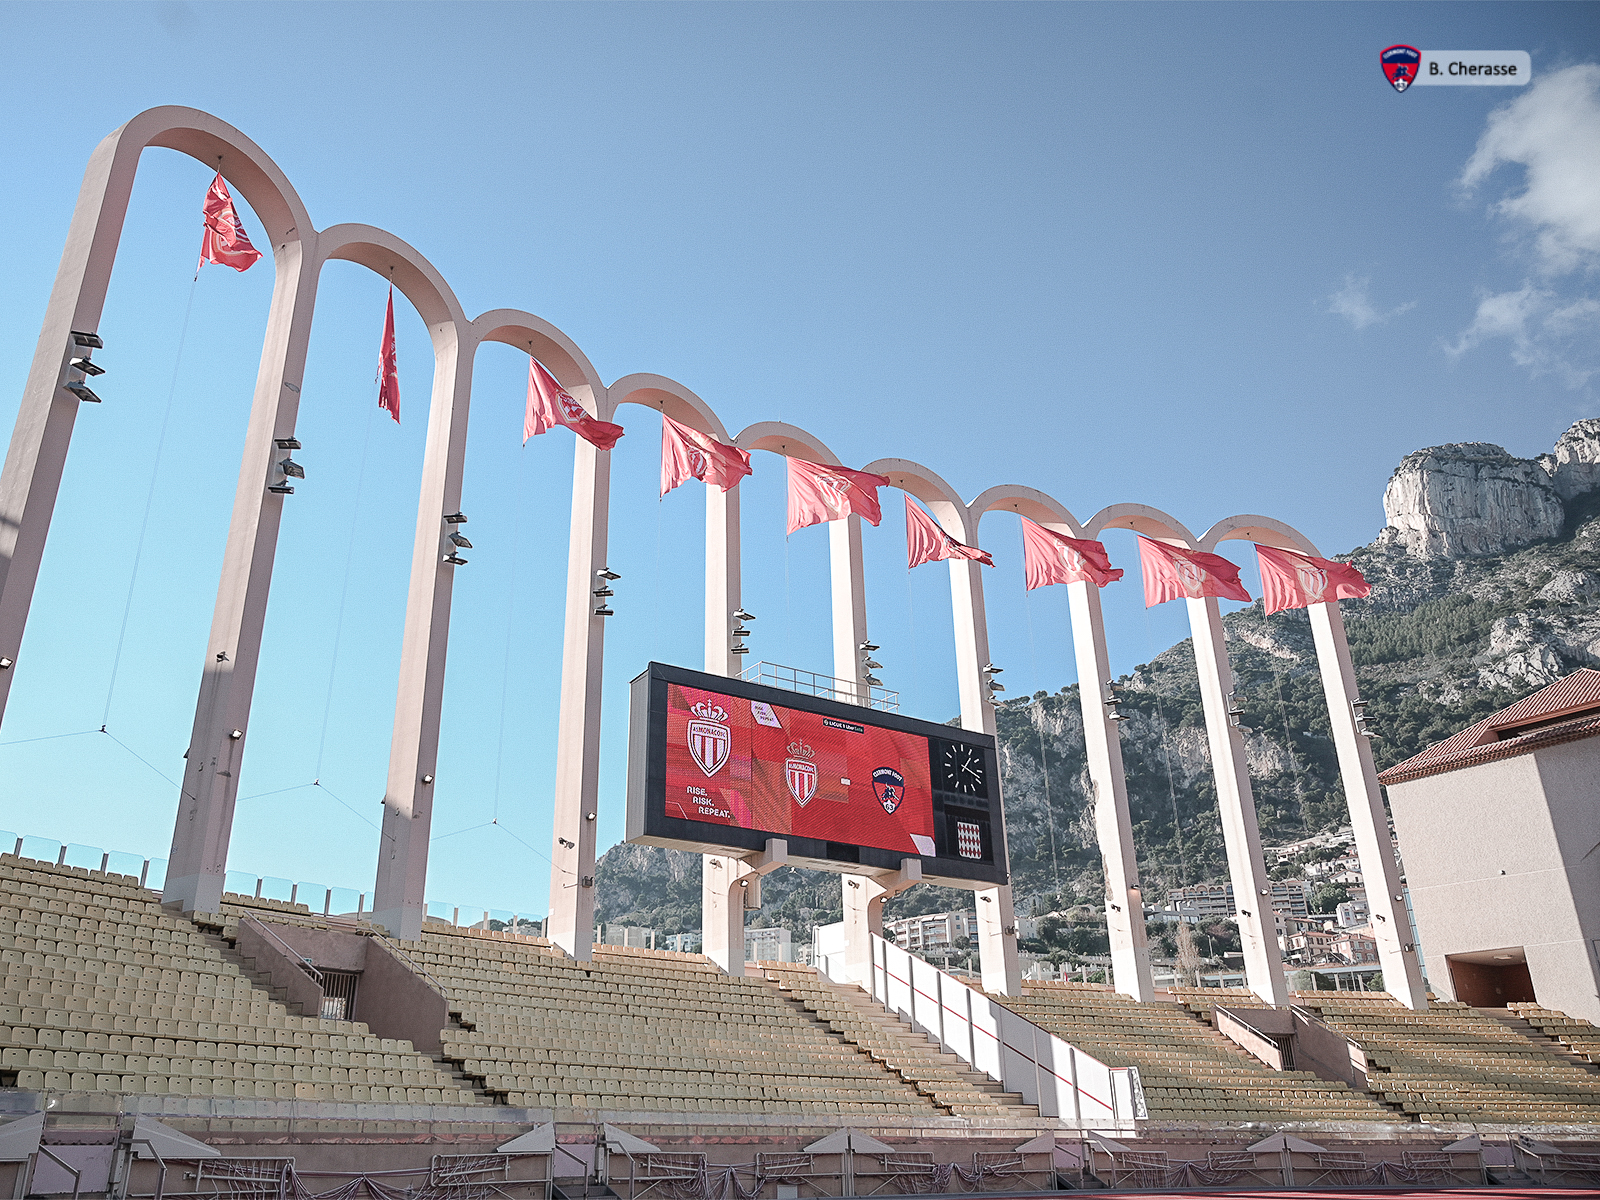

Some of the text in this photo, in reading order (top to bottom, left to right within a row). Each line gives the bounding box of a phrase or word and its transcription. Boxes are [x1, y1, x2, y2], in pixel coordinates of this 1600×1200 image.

[686, 785, 708, 797] RISE.
[692, 795, 715, 807] RISK.
[698, 805, 731, 819] REPEAT.
